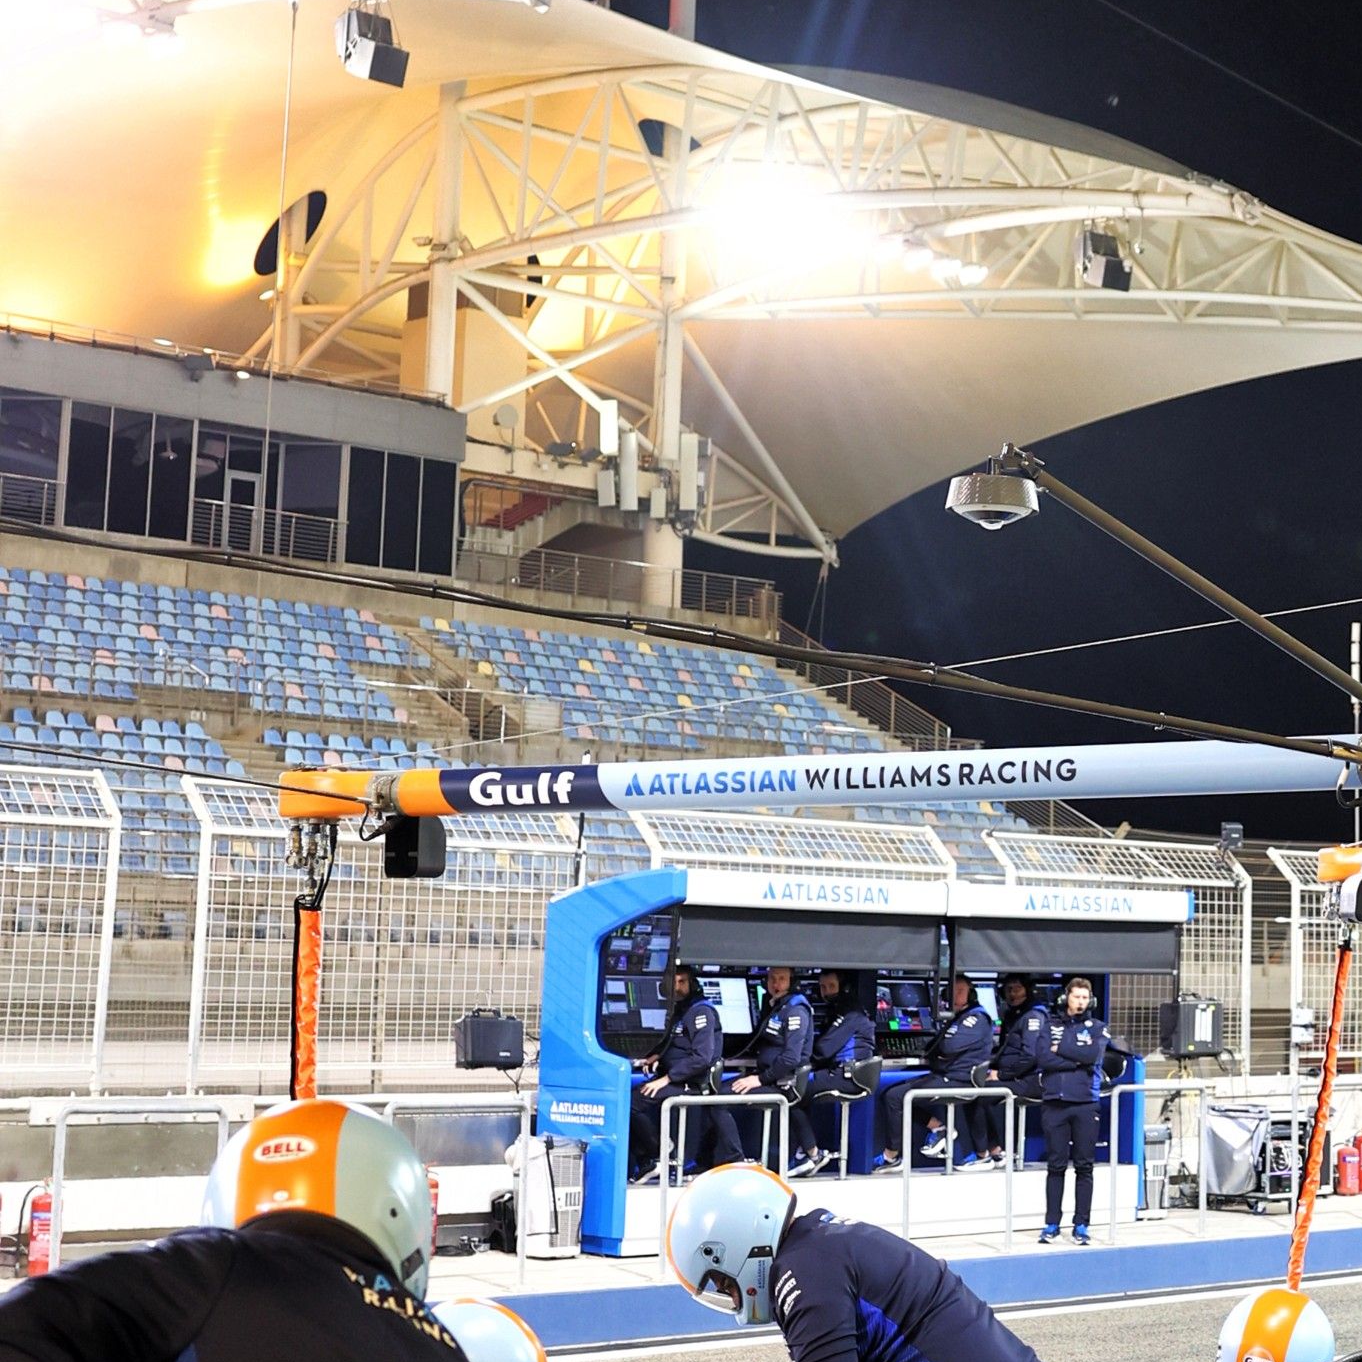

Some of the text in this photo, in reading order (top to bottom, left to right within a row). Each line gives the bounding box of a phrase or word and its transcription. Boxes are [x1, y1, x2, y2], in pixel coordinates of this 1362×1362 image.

[648, 758, 1078, 796] ATLASSIAN WILLIAMS RACING
[469, 771, 575, 806] Gulf
[781, 883, 889, 905] ATLASSIAN
[1041, 894, 1134, 913] ATLASSIAN
[558, 1101, 605, 1116] ATLASSIAN
[261, 1141, 307, 1157] BELL
